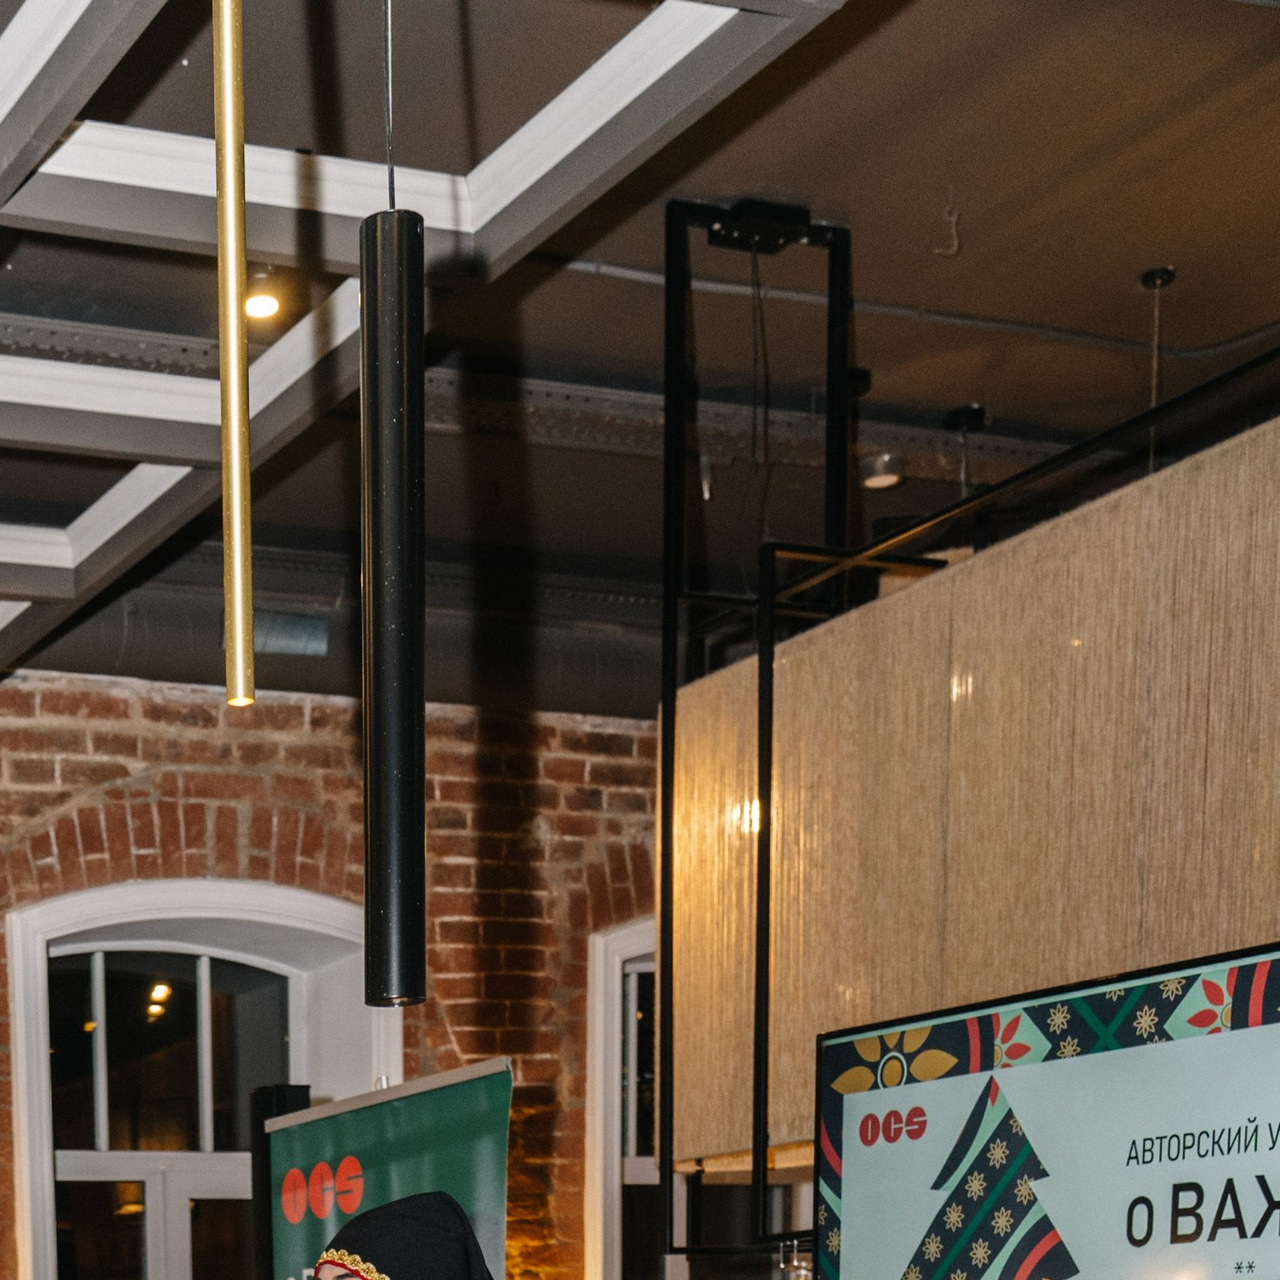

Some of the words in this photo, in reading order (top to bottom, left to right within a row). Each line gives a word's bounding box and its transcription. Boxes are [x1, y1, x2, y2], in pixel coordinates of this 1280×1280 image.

[859, 1106, 928, 1148] OCS
[1126, 1116, 1259, 1167] АВТОРСКИЙ
[281, 1155, 365, 1226] OCS
